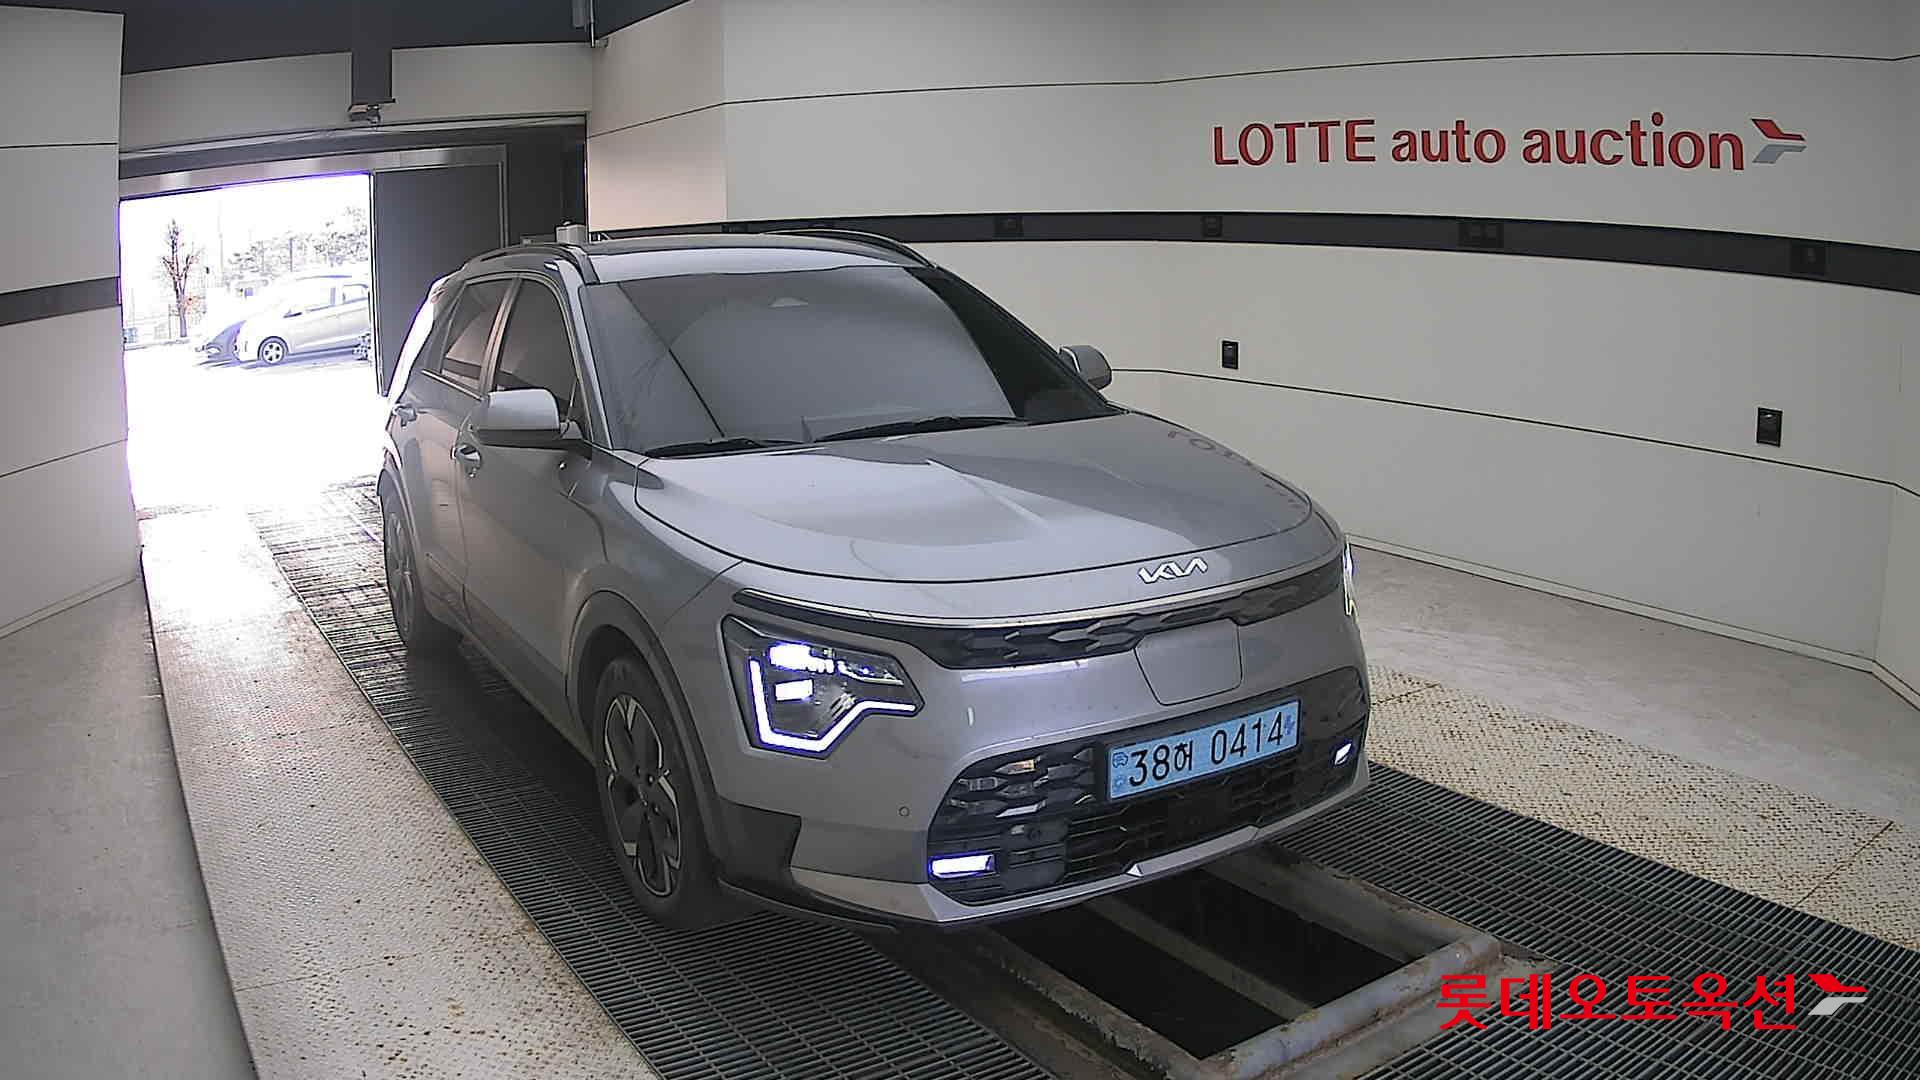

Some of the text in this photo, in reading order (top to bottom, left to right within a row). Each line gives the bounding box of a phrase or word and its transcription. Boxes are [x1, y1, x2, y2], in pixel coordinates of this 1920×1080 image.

[1213, 111, 1745, 171] LOTTE auto auction
[1138, 557, 1208, 584] KIA
[1129, 711, 1283, 787] 38허 0414
